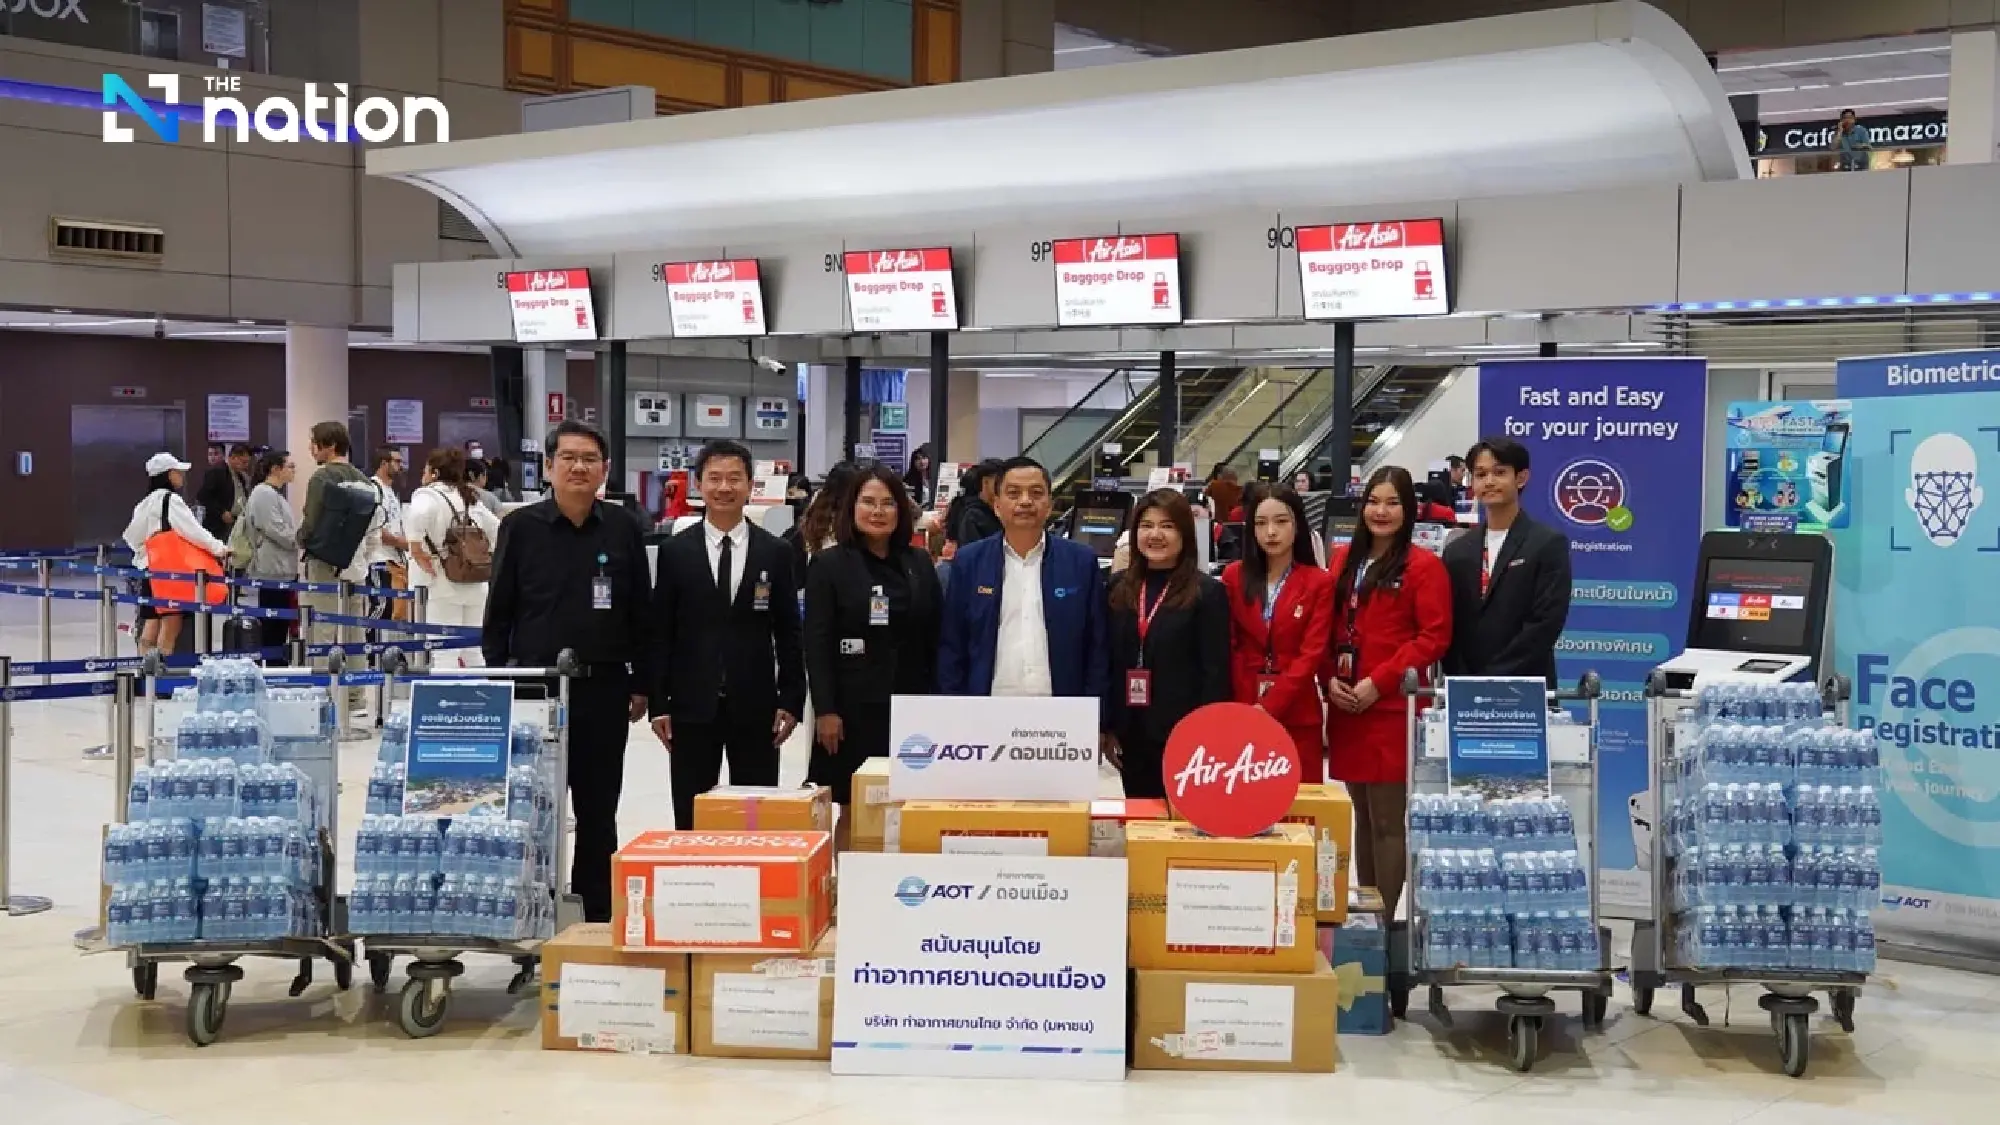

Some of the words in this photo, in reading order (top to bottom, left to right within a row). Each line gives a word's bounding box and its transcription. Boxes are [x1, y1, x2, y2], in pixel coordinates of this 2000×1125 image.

[1868, 122, 1948, 143] mazo
[1267, 226, 1295, 249] 9Q
[1031, 240, 1052, 261] 9P
[824, 253, 843, 272] 9N
[1308, 261, 1368, 275] Baggage
[1371, 258, 1404, 271] Drop
[1520, 386, 1561, 406] Fast
[1568, 386, 1608, 406] and
[1616, 386, 1664, 410] Easy
[1505, 416, 1534, 436] for
[1542, 422, 1589, 440] your
[1594, 416, 1679, 441] journey
[1571, 541, 1633, 553] Registration
[1571, 585, 1673, 600] ทะเบียนใบหน้า
[1857, 653, 1976, 713] Face
[937, 744, 989, 761] AOT
[1009, 742, 1092, 761] ดอนเมือง
[931, 884, 974, 899] AOT
[996, 882, 1069, 900] ดอนเมือง
[1903, 896, 1931, 908] AOT
[921, 934, 1040, 959] สนับสนุนโดย
[854, 962, 1106, 990] ท่าอากาศยานดอนเมือง
[864, 1016, 898, 1028] บริษัท
[902, 1015, 1001, 1030] ท่าอากาศยานไทย
[1006, 1017, 1038, 1031] จำกัด
[1043, 1019, 1094, 1034] (มหาชน)
